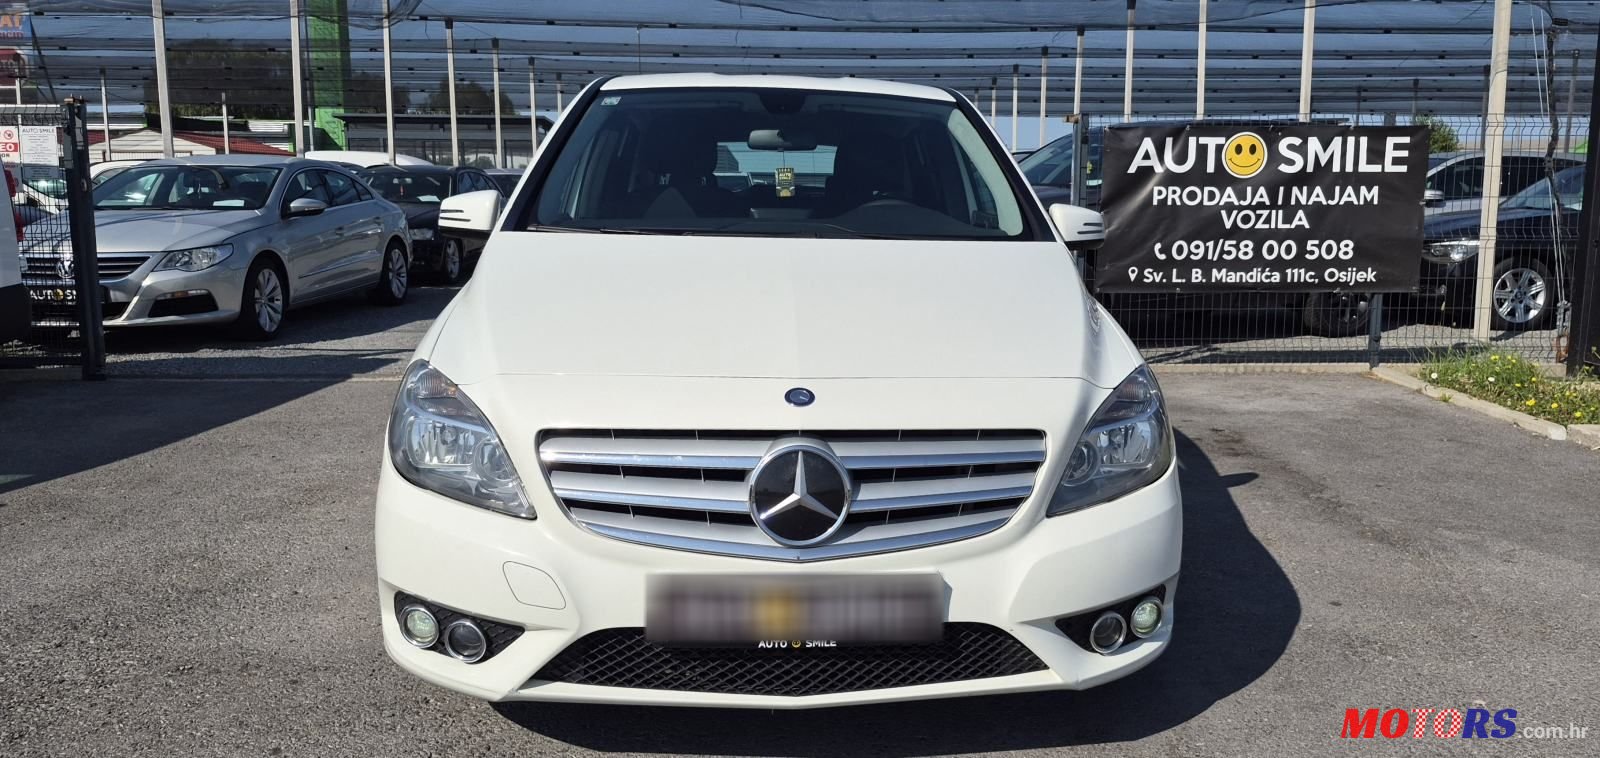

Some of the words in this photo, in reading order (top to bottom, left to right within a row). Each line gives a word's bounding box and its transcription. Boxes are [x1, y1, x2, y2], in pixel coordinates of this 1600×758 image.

[1278, 136, 1411, 173] SMILE
[1152, 186, 1271, 206] PRODAJA
[1290, 185, 1379, 206] NAJAM
[1220, 210, 1310, 230] VOZILA
[1171, 239, 1254, 261] 091/58
[1261, 240, 1297, 260] 00
[1305, 239, 1355, 260] 508
[1143, 268, 1167, 283] Sv.
[1171, 269, 1186, 283] L.
[1191, 268, 1206, 283] B.
[1211, 266, 1281, 284] Mandića
[1285, 267, 1319, 285] 111c,
[1324, 267, 1377, 286] Osijek
[758, 640, 788, 649] AUTO
[805, 640, 837, 648] SMILE
